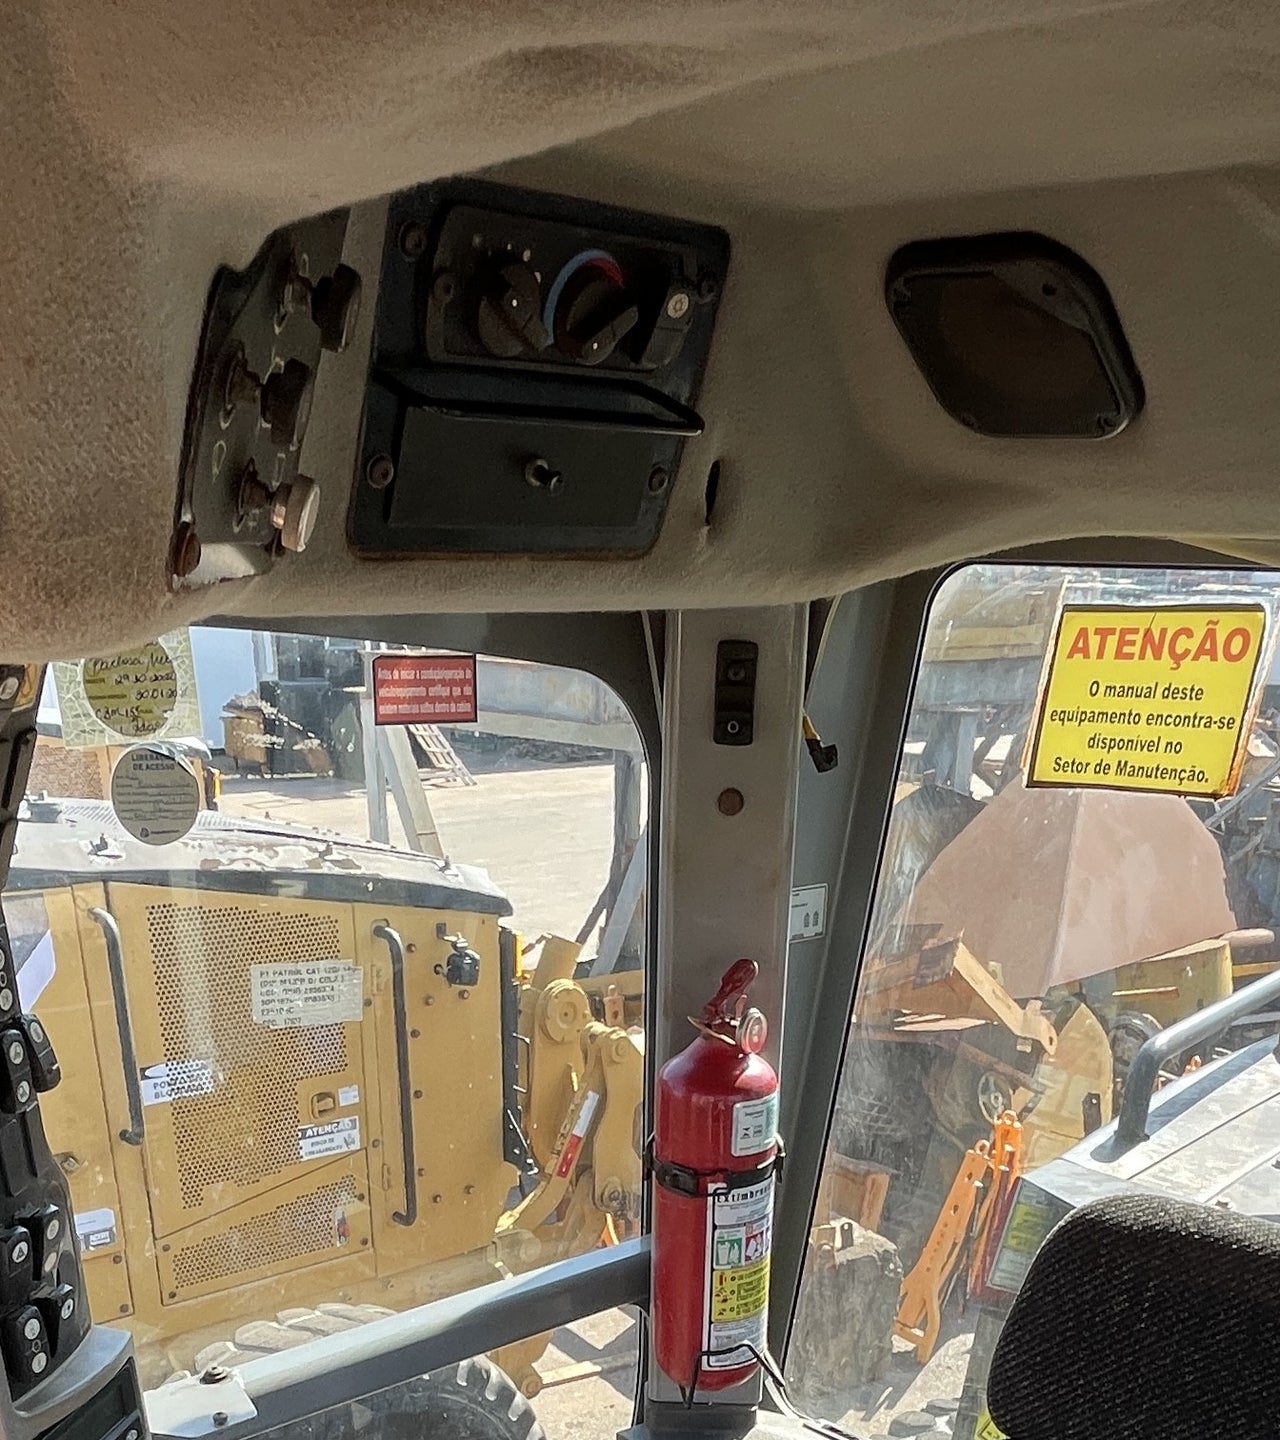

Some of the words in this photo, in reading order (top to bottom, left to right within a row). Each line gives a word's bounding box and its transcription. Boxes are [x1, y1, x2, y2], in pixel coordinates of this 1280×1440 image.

[1066, 618, 1252, 670] ATENÇÃO
[1089, 680, 1100, 697] O
[1104, 682, 1158, 700] manual
[1161, 683, 1204, 701] deste
[1050, 706, 1141, 727] equipamento
[1146, 711, 1236, 730] encontra-se
[1087, 732, 1161, 755] disponível
[1164, 740, 1183, 754] no
[1053, 756, 1090, 774] Setor
[1093, 758, 1111, 776] de
[1115, 760, 1210, 785] Manutenção.
[305, 1118, 352, 1137] ATENÇÃO
